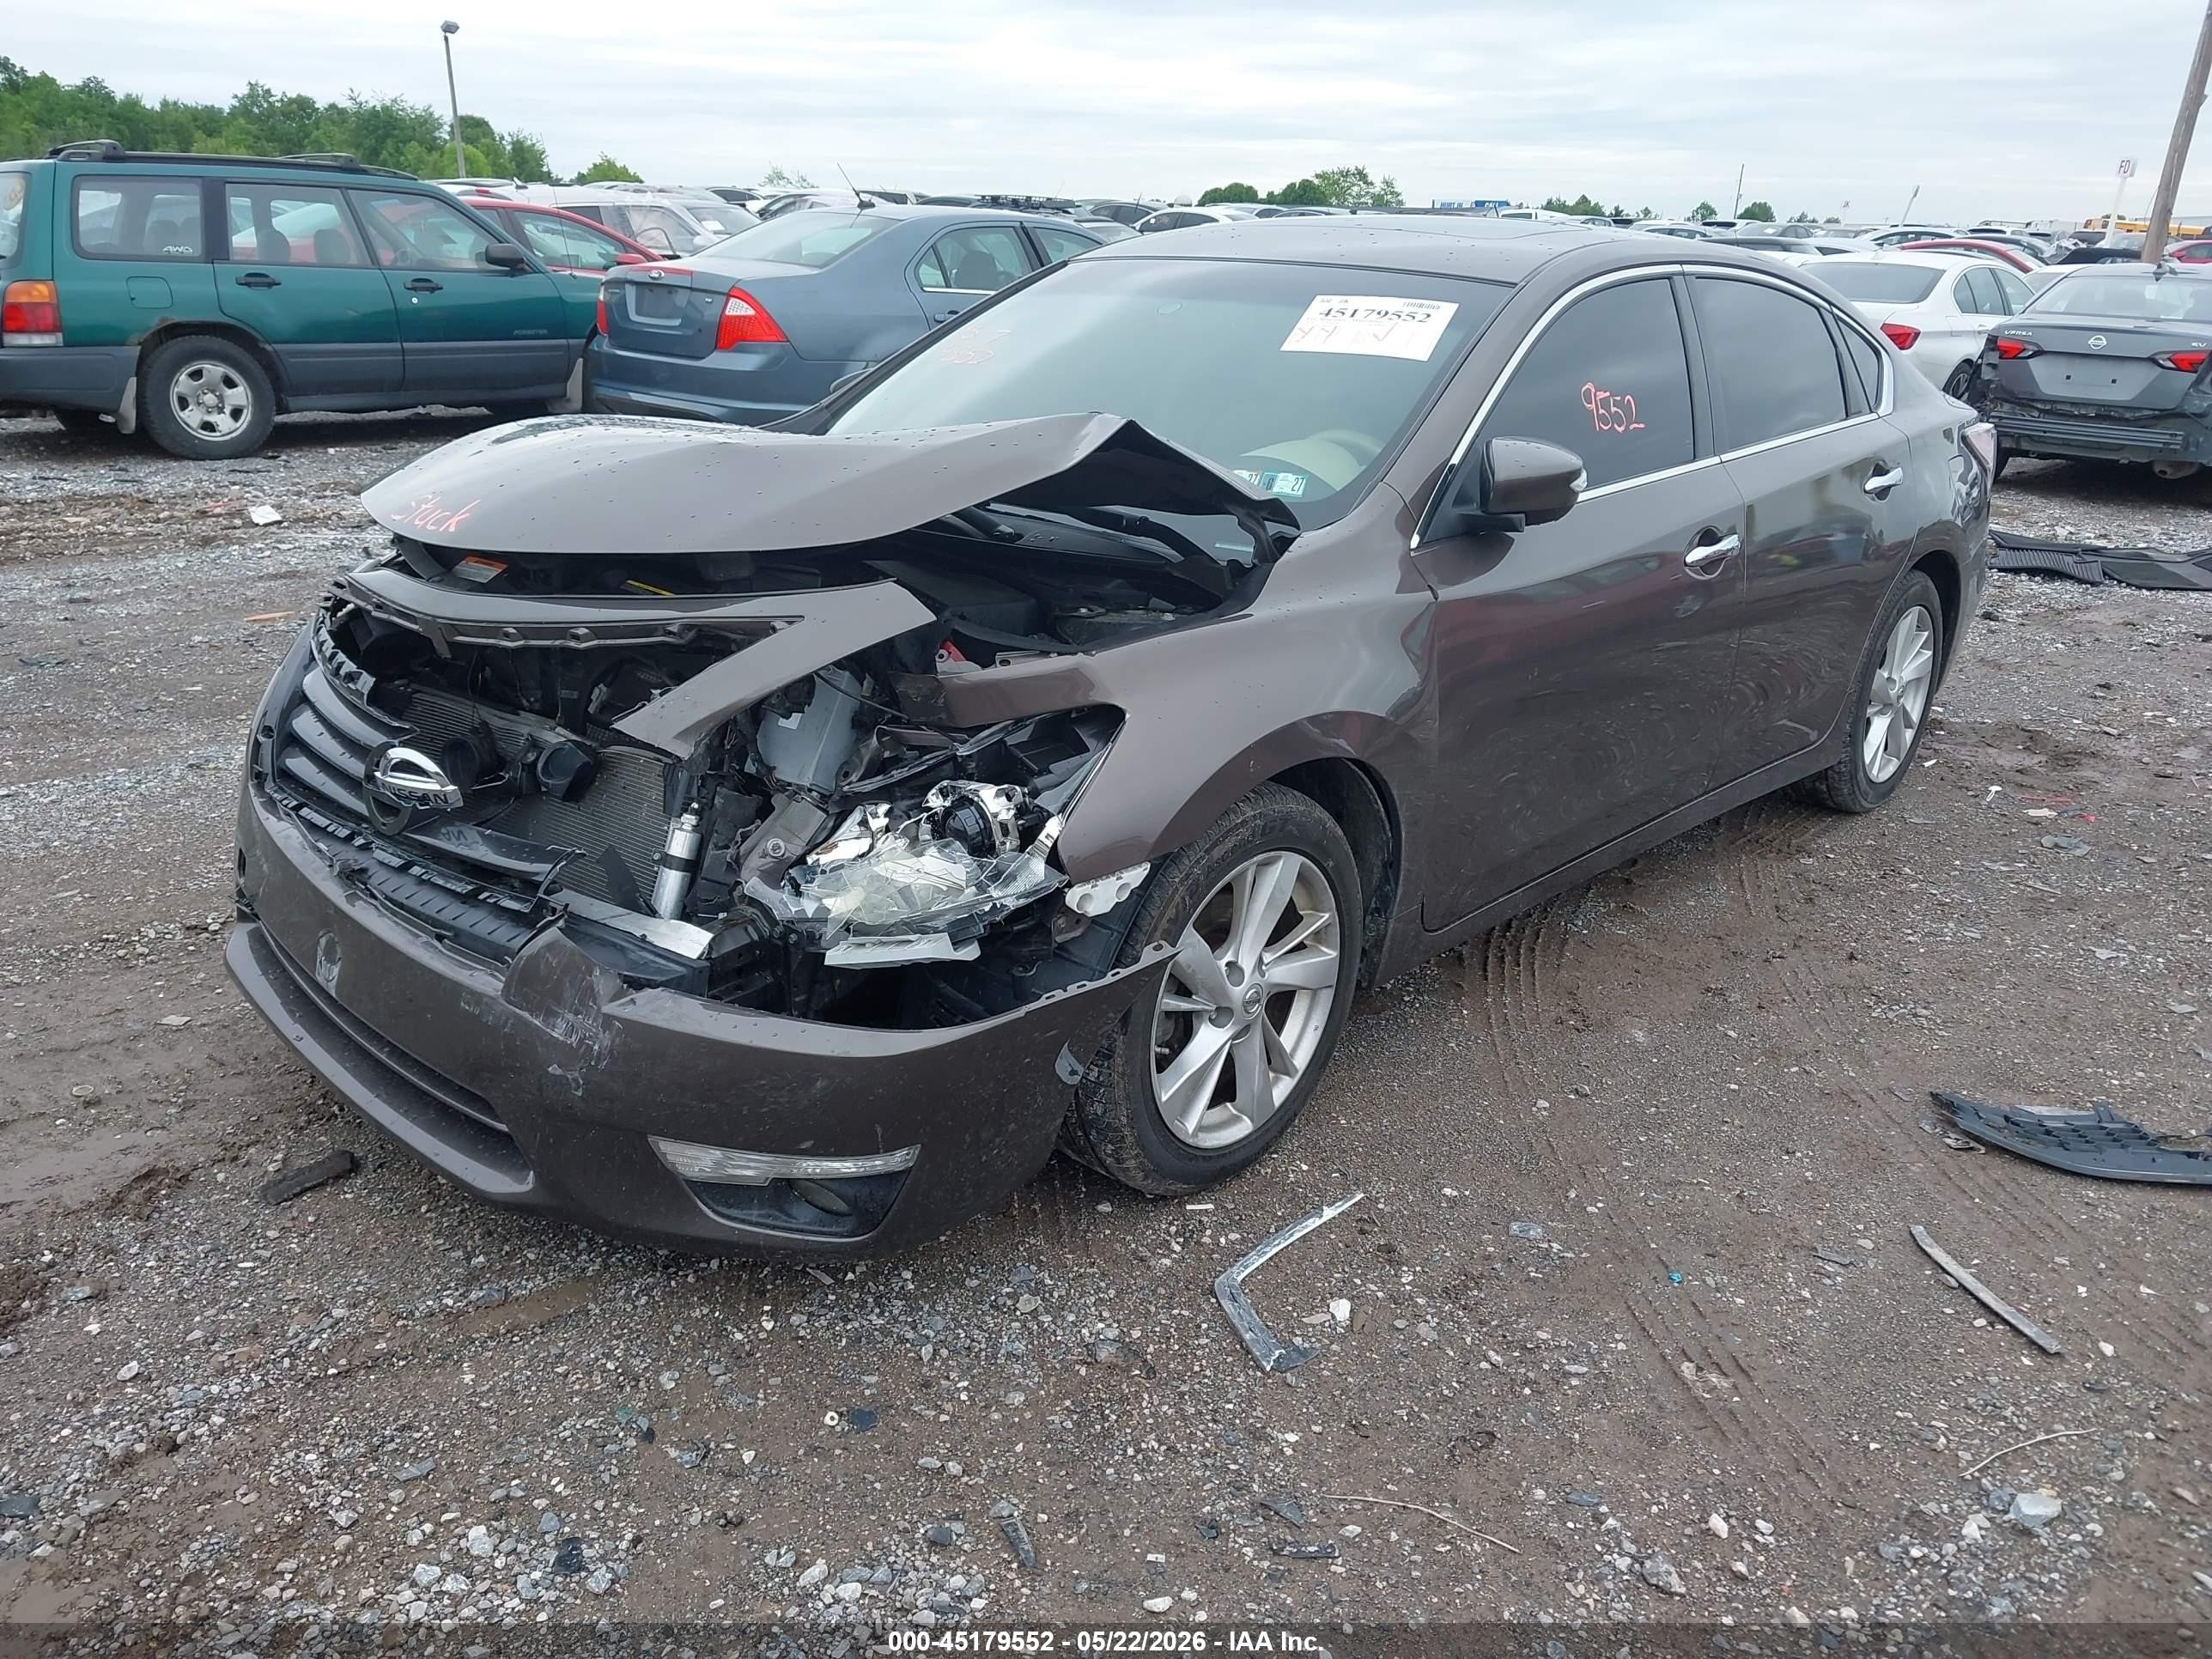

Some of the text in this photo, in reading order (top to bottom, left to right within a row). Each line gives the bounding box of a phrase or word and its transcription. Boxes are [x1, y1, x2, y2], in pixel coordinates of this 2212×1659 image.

[2118, 159, 2131, 174] FD
[1319, 307, 1432, 323] 45179552
[1581, 382, 1646, 433] 9552
[1291, 477, 1305, 493] 27
[380, 781, 450, 805] NISSAN
